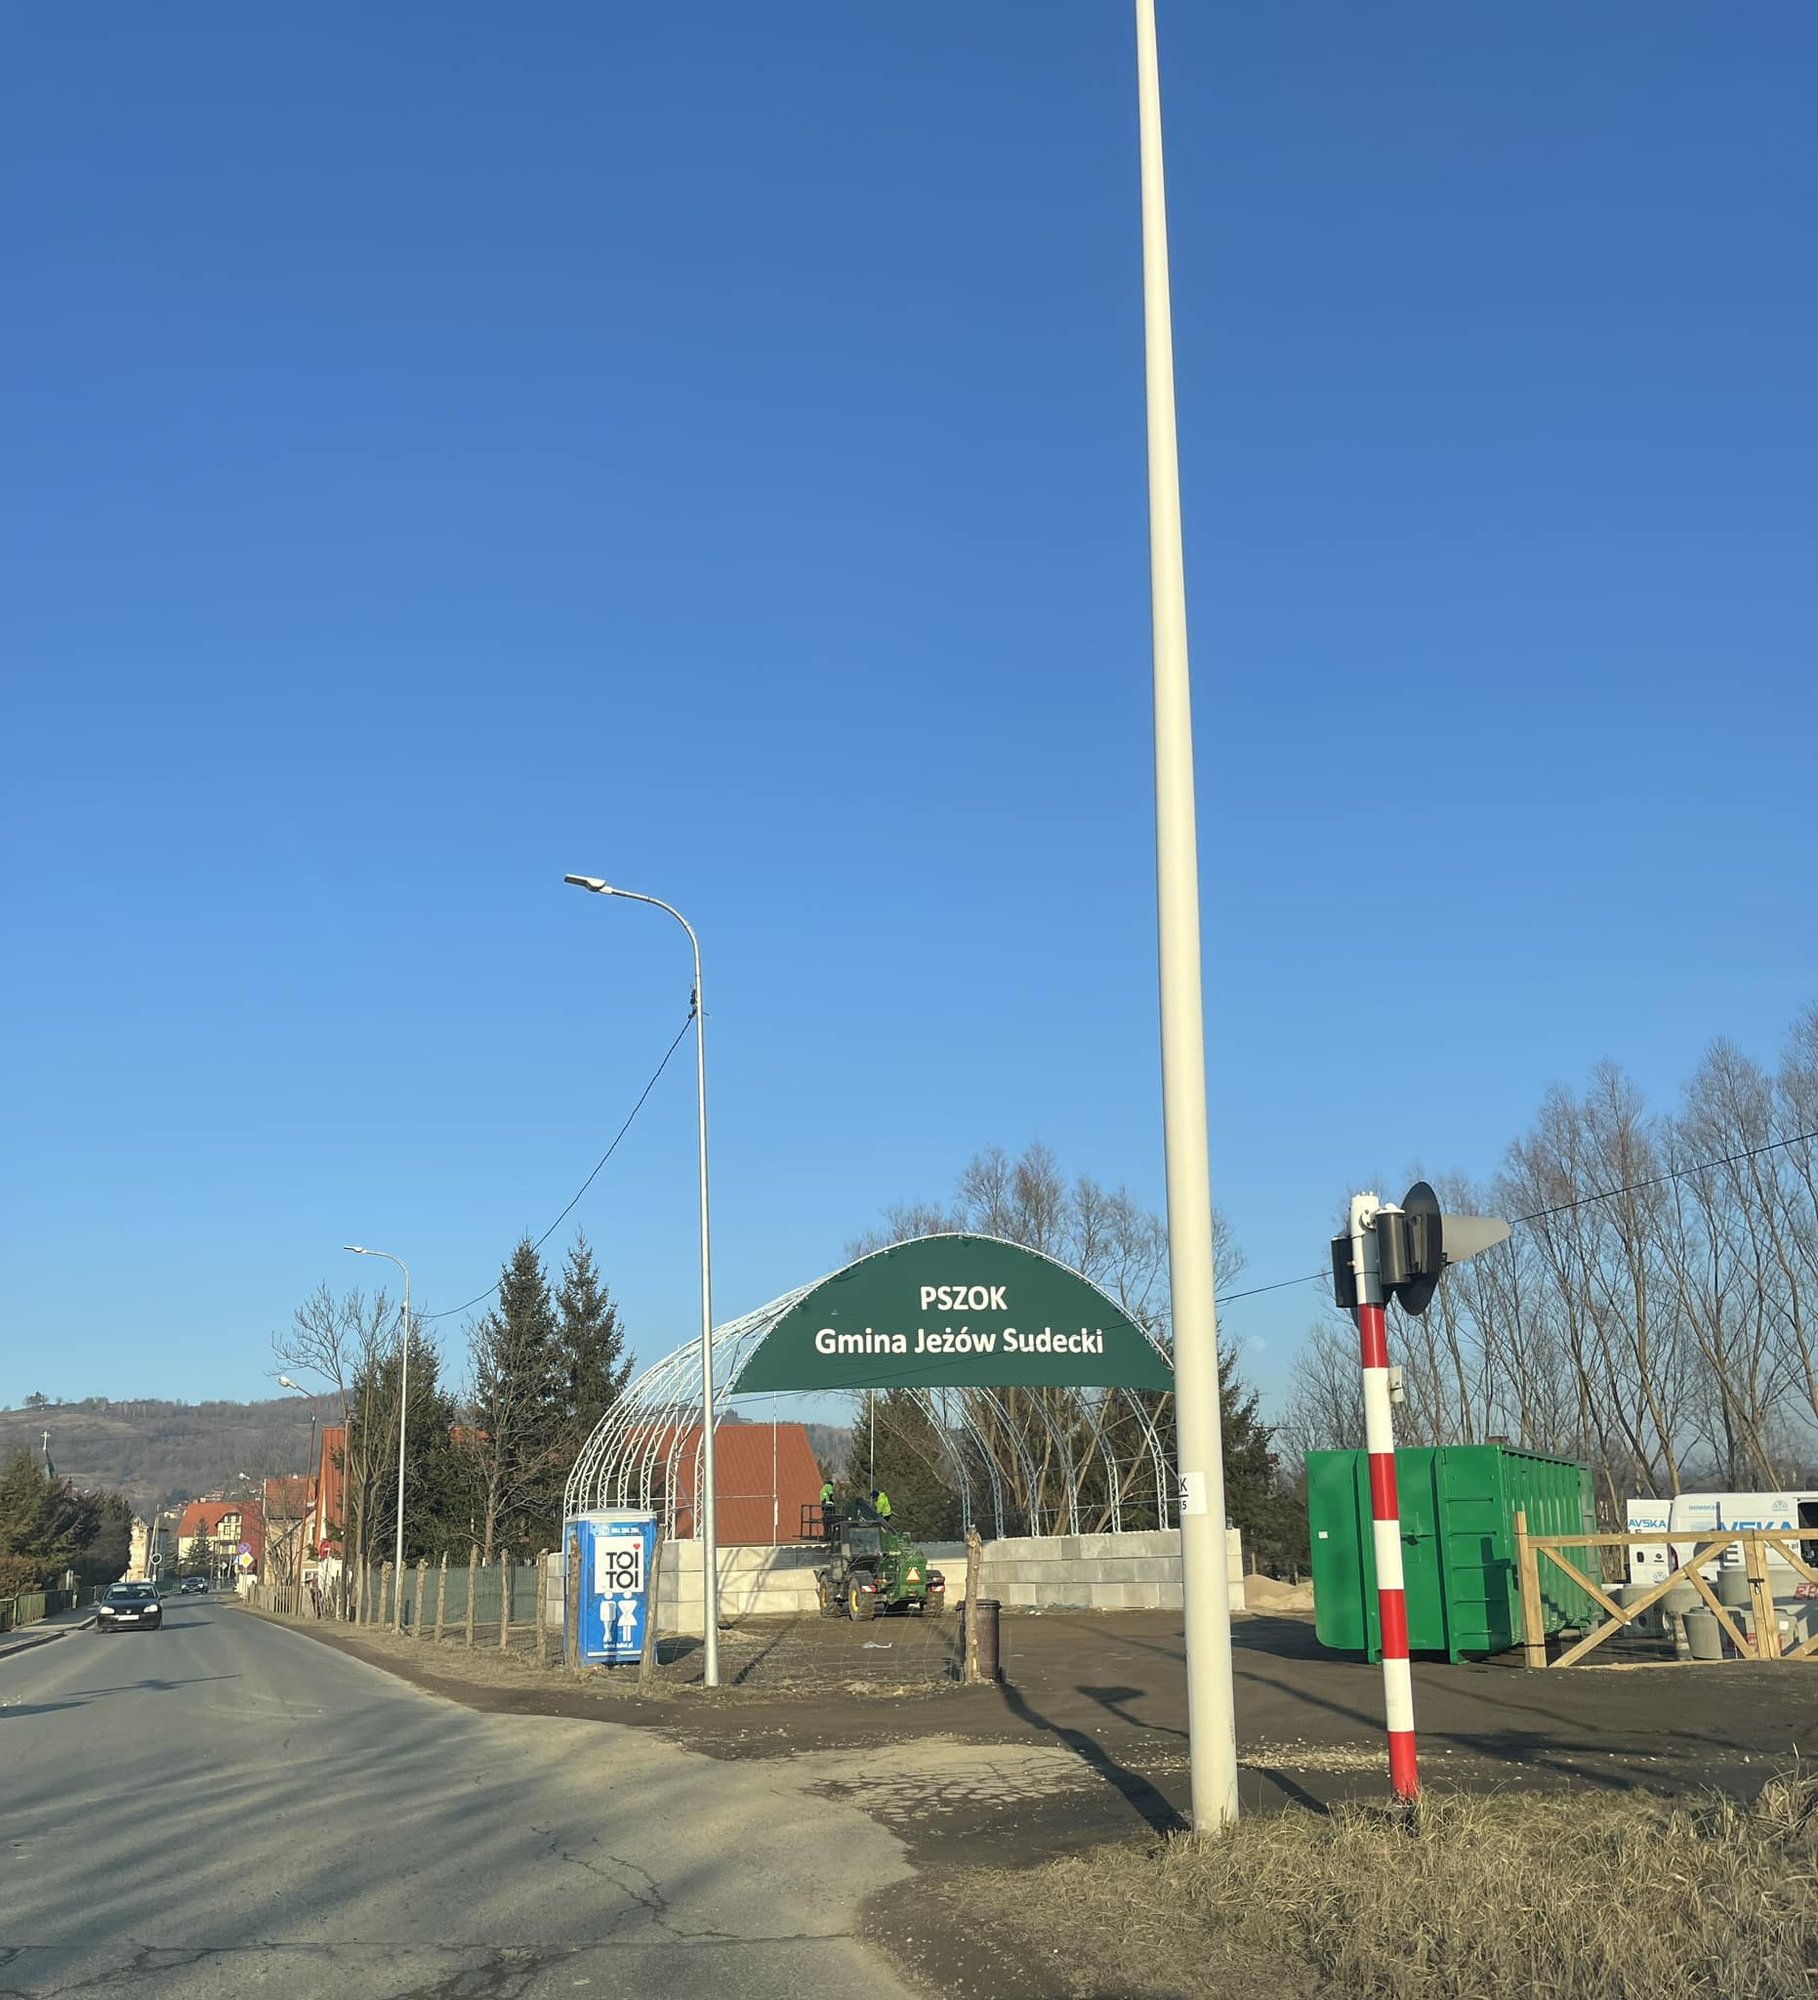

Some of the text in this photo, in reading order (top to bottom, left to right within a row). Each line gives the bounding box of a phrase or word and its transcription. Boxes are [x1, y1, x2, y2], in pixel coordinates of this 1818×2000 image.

[920, 1286, 1008, 1311] PSZOK
[815, 1326, 1103, 1354] Gmina Jeżów Sudecki
[605, 1551, 639, 1569] TOI
[605, 1570, 639, 1588] TOI
